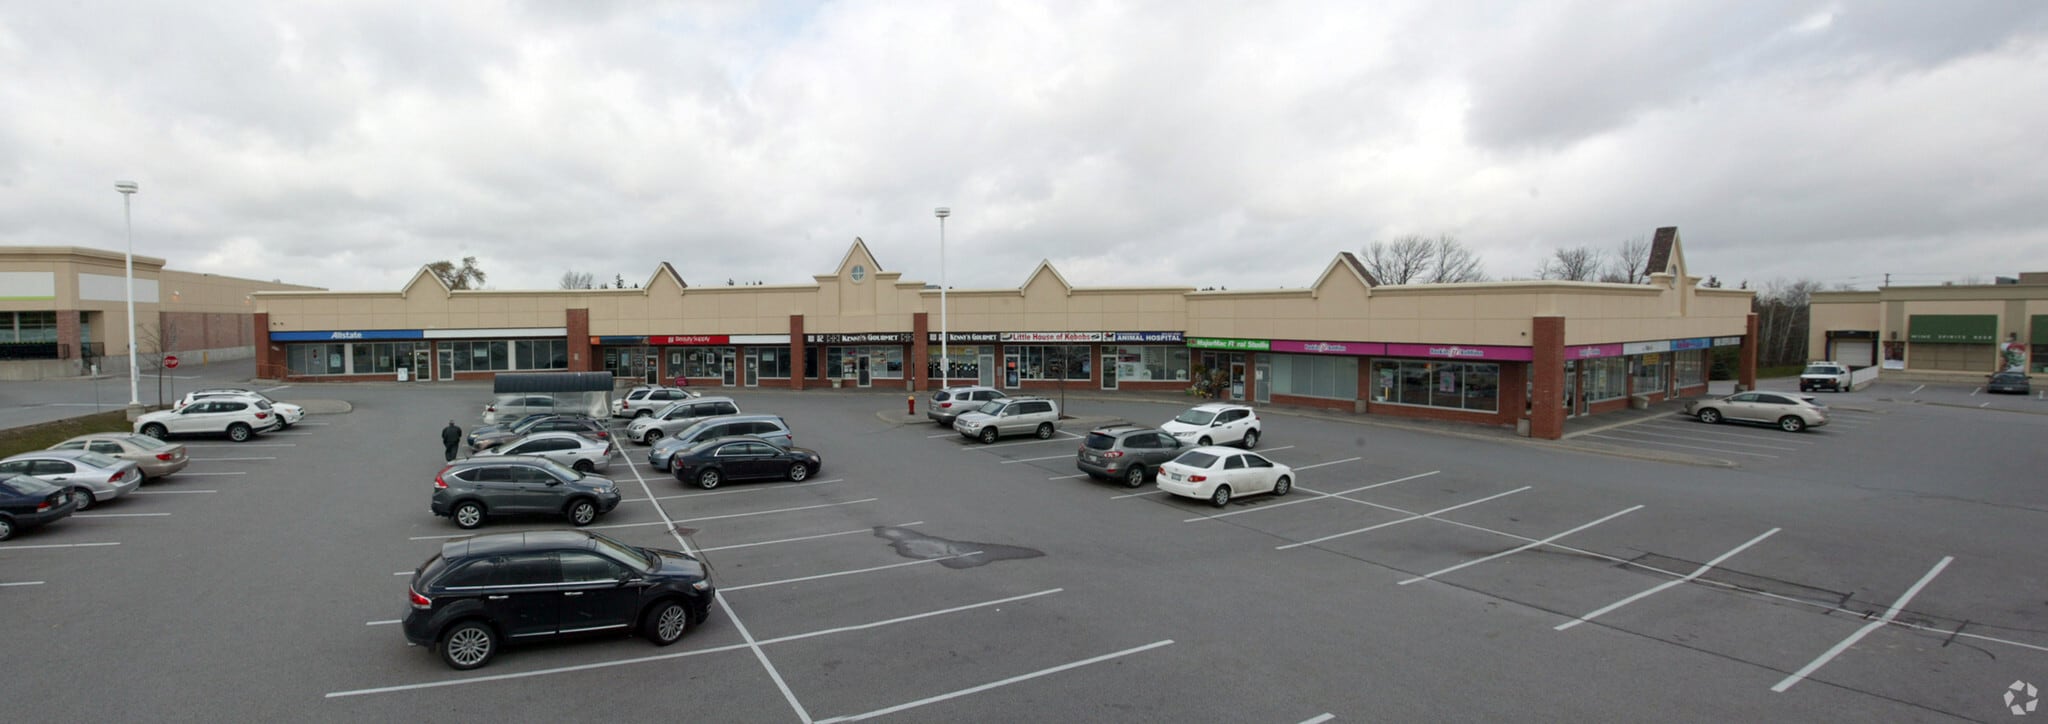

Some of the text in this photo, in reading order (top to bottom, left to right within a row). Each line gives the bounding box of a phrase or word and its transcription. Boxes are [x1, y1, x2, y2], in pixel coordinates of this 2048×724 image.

[330, 331, 362, 339] Allstate
[1013, 332, 1031, 340] Little
[1032, 332, 1054, 340] House
[1056, 332, 1063, 340] of
